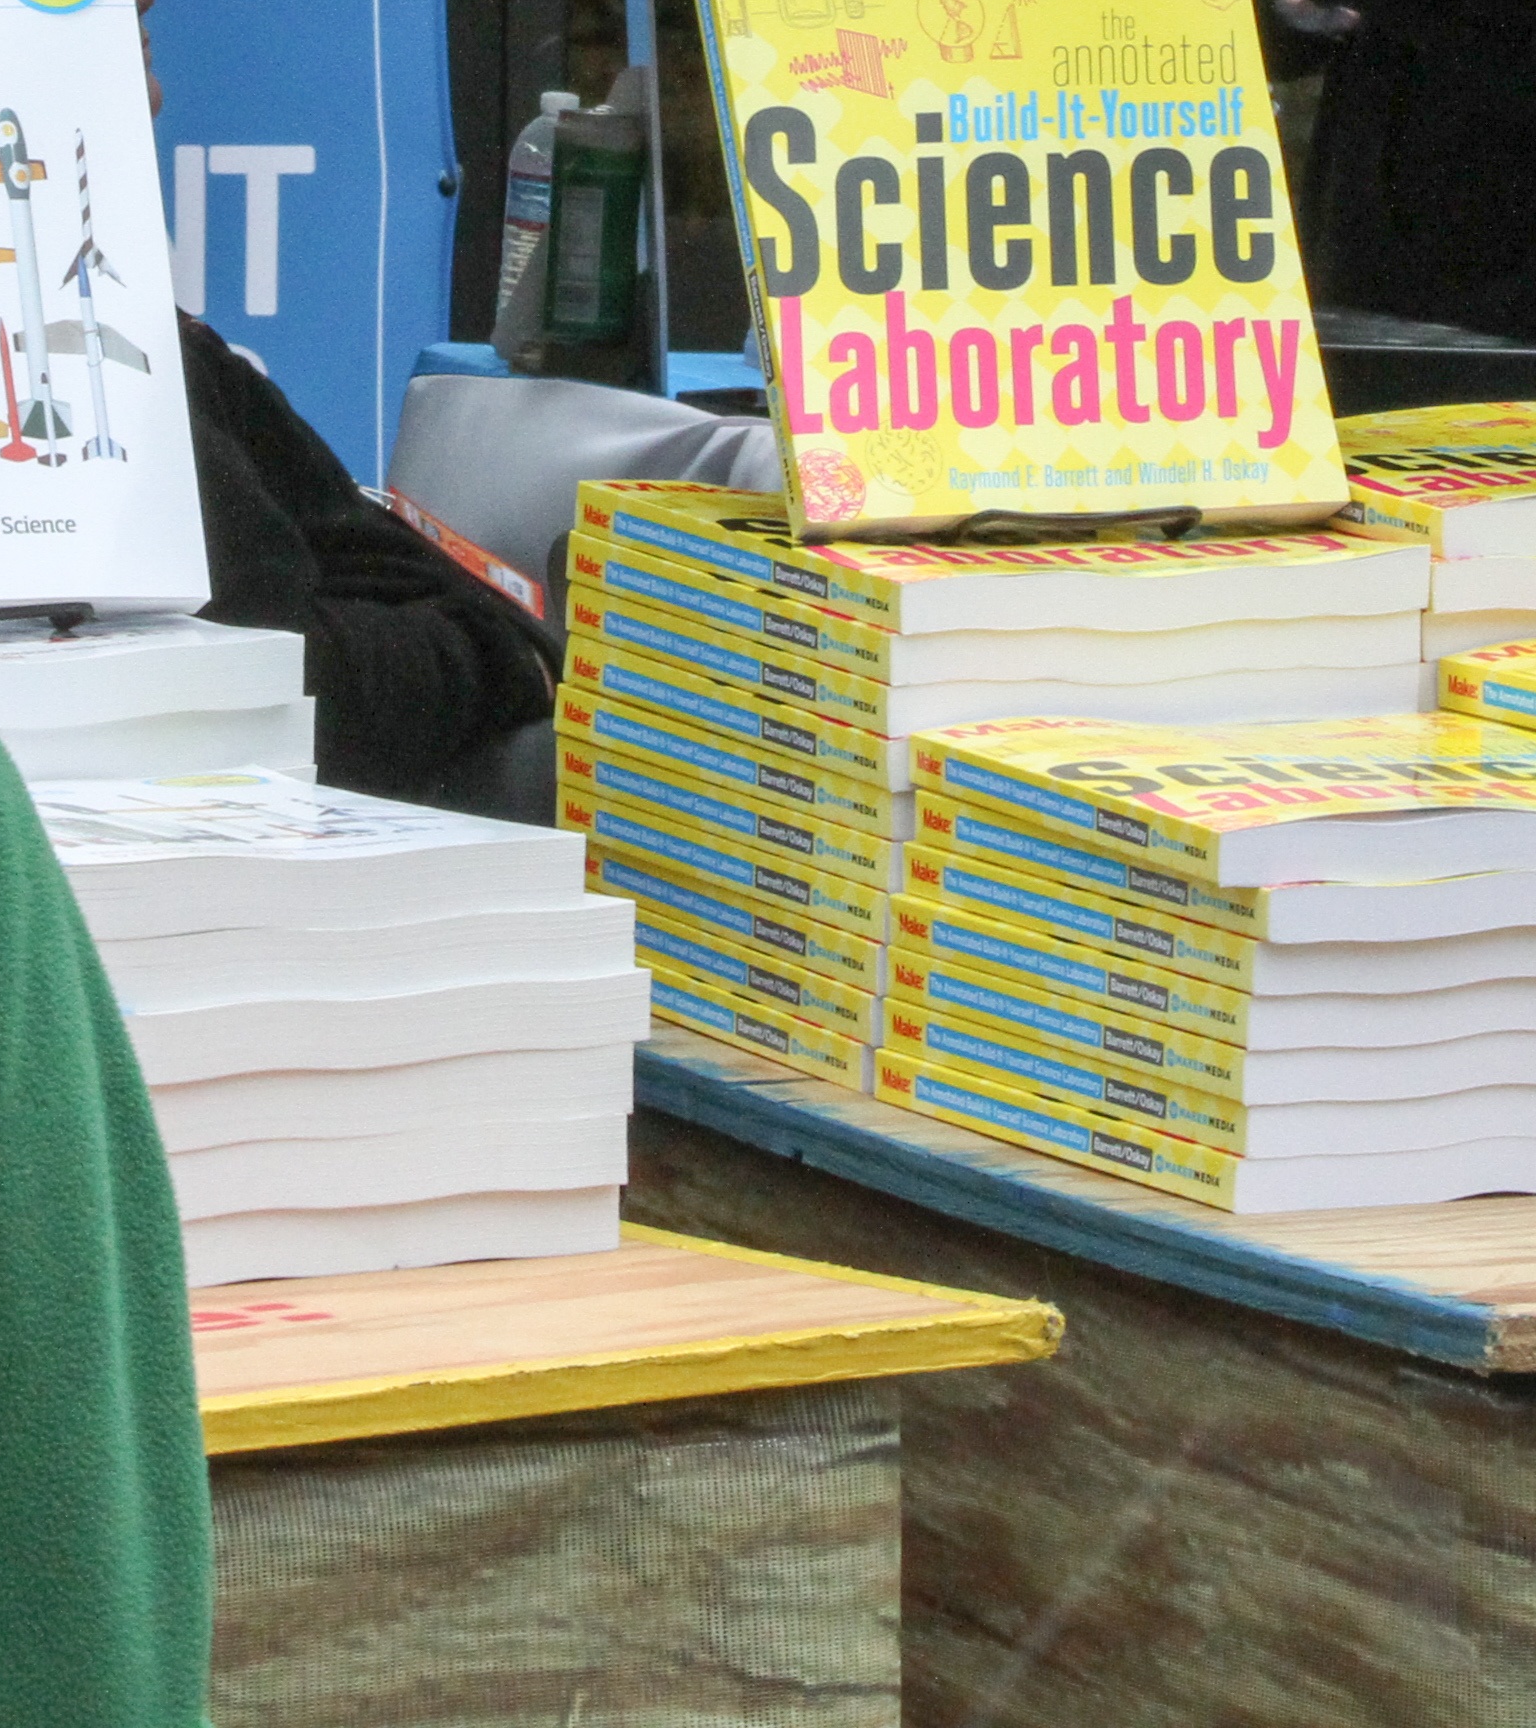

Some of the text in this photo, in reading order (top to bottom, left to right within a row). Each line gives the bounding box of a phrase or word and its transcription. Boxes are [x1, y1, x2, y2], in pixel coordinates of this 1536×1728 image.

[1100, 8, 1136, 41] the
[1052, 30, 1238, 88] annotated
[948, 87, 1244, 143] Build-It-Yourself
[743, 105, 1276, 298] Science
[777, 289, 1300, 449] Laboratory
[948, 458, 1270, 492] Raymond E. Barrett and Windell H. Oskay
[1, 515, 77, 535] Science
[807, 532, 1350, 572] Laboratory
[1448, 673, 1478, 699] Make:
[924, 807, 950, 833] Make:
[911, 858, 939, 885] Make:
[899, 912, 927, 939] Make:
[895, 962, 923, 989] Make:
[893, 1014, 922, 1041] Make:
[882, 1066, 910, 1094] Make:
